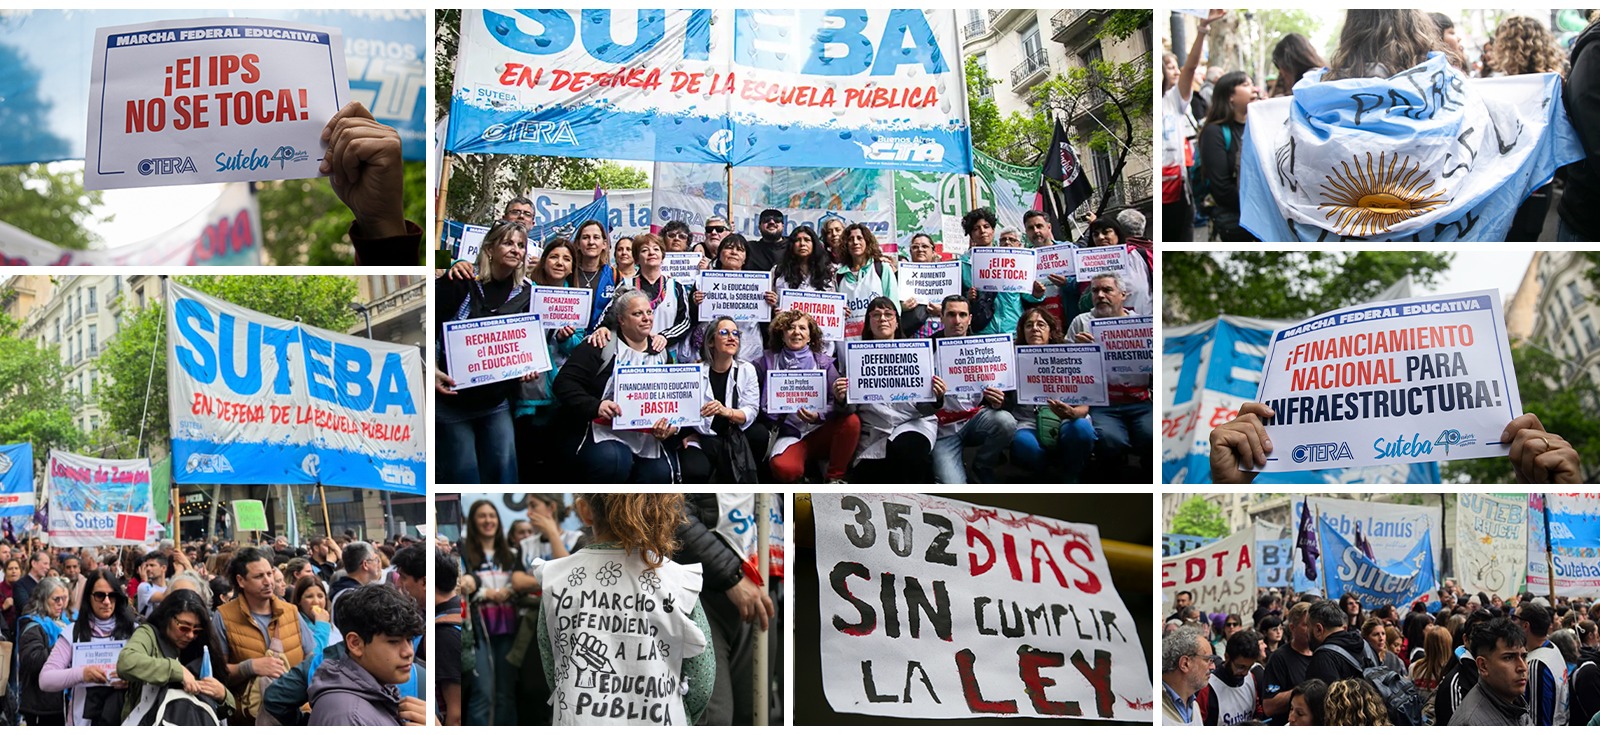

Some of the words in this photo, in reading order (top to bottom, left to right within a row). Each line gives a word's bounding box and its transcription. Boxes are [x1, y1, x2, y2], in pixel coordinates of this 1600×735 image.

[116, 31, 176, 46] MARCHA
[180, 28, 241, 41] FEDERAL
[244, 28, 320, 43] EDUCATIVA
[482, 9, 951, 77] SUTEBA
[164, 56, 200, 97] ¡El
[208, 53, 260, 86] IPS
[499, 62, 544, 89] EN
[669, 70, 705, 93] DE
[708, 71, 735, 96] LA
[740, 79, 837, 108] ESCUELA
[844, 82, 939, 109] PÚBLICA
[477, 88, 518, 102] SUTEBA
[125, 97, 166, 134] NO
[173, 94, 209, 131] SE
[214, 88, 309, 127] TOCA!
[481, 120, 580, 147] CTERA
[877, 135, 911, 144] Buenos
[137, 156, 198, 176] CTERA
[215, 148, 271, 173] Suteba
[1001, 257, 1016, 268] IPS
[919, 271, 946, 279] AUMENTO
[979, 269, 990, 279] NO
[991, 269, 1002, 279] SE
[1003, 269, 1028, 280] TOCA!
[727, 282, 759, 292] EDUCACIÓN
[914, 279, 952, 287] PRESUPUESTO
[543, 296, 580, 305] RECHAZAMOS
[554, 304, 574, 312] AJUSTE
[712, 303, 716, 311] y
[722, 302, 759, 310] DEMOCRACIA
[451, 322, 479, 331] MARCHA
[480, 318, 506, 327] FEDERAL
[506, 315, 536, 324] EDUCATIVA
[827, 316, 840, 327] YA!
[1283, 316, 1336, 338] MARCHA
[1339, 307, 1400, 324] FEDERAL
[1403, 299, 1481, 316] EDUCATIVA
[465, 328, 527, 347] RECHAZAMOS
[1105, 339, 1146, 350] NACIONAL
[174, 297, 417, 415] SUTEBA
[477, 346, 486, 358] el
[487, 341, 520, 357] AJUSTE
[959, 348, 965, 356] A
[974, 346, 995, 356] Profes
[1285, 324, 1474, 372] ¡FINANCIAMIENTO
[468, 361, 481, 373] en
[482, 352, 533, 371] EDUCACIÓN
[861, 353, 918, 367] ¡DEFENDEMOS
[967, 356, 976, 364] 20
[976, 354, 1001, 364] módulos
[1033, 357, 1038, 365] A
[860, 366, 877, 377] LOS
[877, 365, 920, 376] DERECHOS
[949, 366, 962, 375] NOS
[963, 365, 983, 374] DEBEN
[984, 364, 989, 372] 11
[990, 363, 1008, 372] PALOS
[1051, 366, 1056, 374] 2
[1056, 367, 1081, 376] cargos
[1290, 358, 1402, 392] NACIONAL
[1406, 351, 1469, 382] PARA
[858, 376, 924, 389] PREVISIONALES!
[964, 373, 976, 382] DEL
[1027, 375, 1041, 384] NOS
[1042, 375, 1063, 384] DEBEN
[1064, 375, 1070, 384] 11
[1071, 375, 1095, 384] PALOS
[619, 382, 667, 391] FINANCIAMIENTO
[668, 381, 700, 390] EDUCATIVO
[1043, 385, 1055, 393] DEL
[649, 392, 657, 400] DE
[658, 391, 665, 399] LA
[666, 391, 692, 400] HISTORIA
[1262, 380, 1502, 426] INFRAESTRUCTURA!
[191, 392, 213, 416] EN
[269, 405, 291, 425] DE
[296, 405, 313, 424] LA
[314, 408, 359, 434] ESCUELA
[360, 418, 411, 442] PÚBLICA
[640, 401, 679, 417] ¡BASTA!
[1291, 441, 1354, 463] CTERA
[1373, 433, 1433, 459] Suteba
[840, 495, 958, 567] 352
[965, 525, 1103, 595] DIAS
[551, 587, 574, 616] Yo
[579, 589, 656, 613] MARCHO
[828, 561, 954, 643] SIN
[973, 595, 1128, 643] CUMPLIR
[614, 641, 626, 660] A
[636, 640, 657, 661] LA
[861, 659, 942, 704] LA
[954, 643, 1117, 718] LEY
